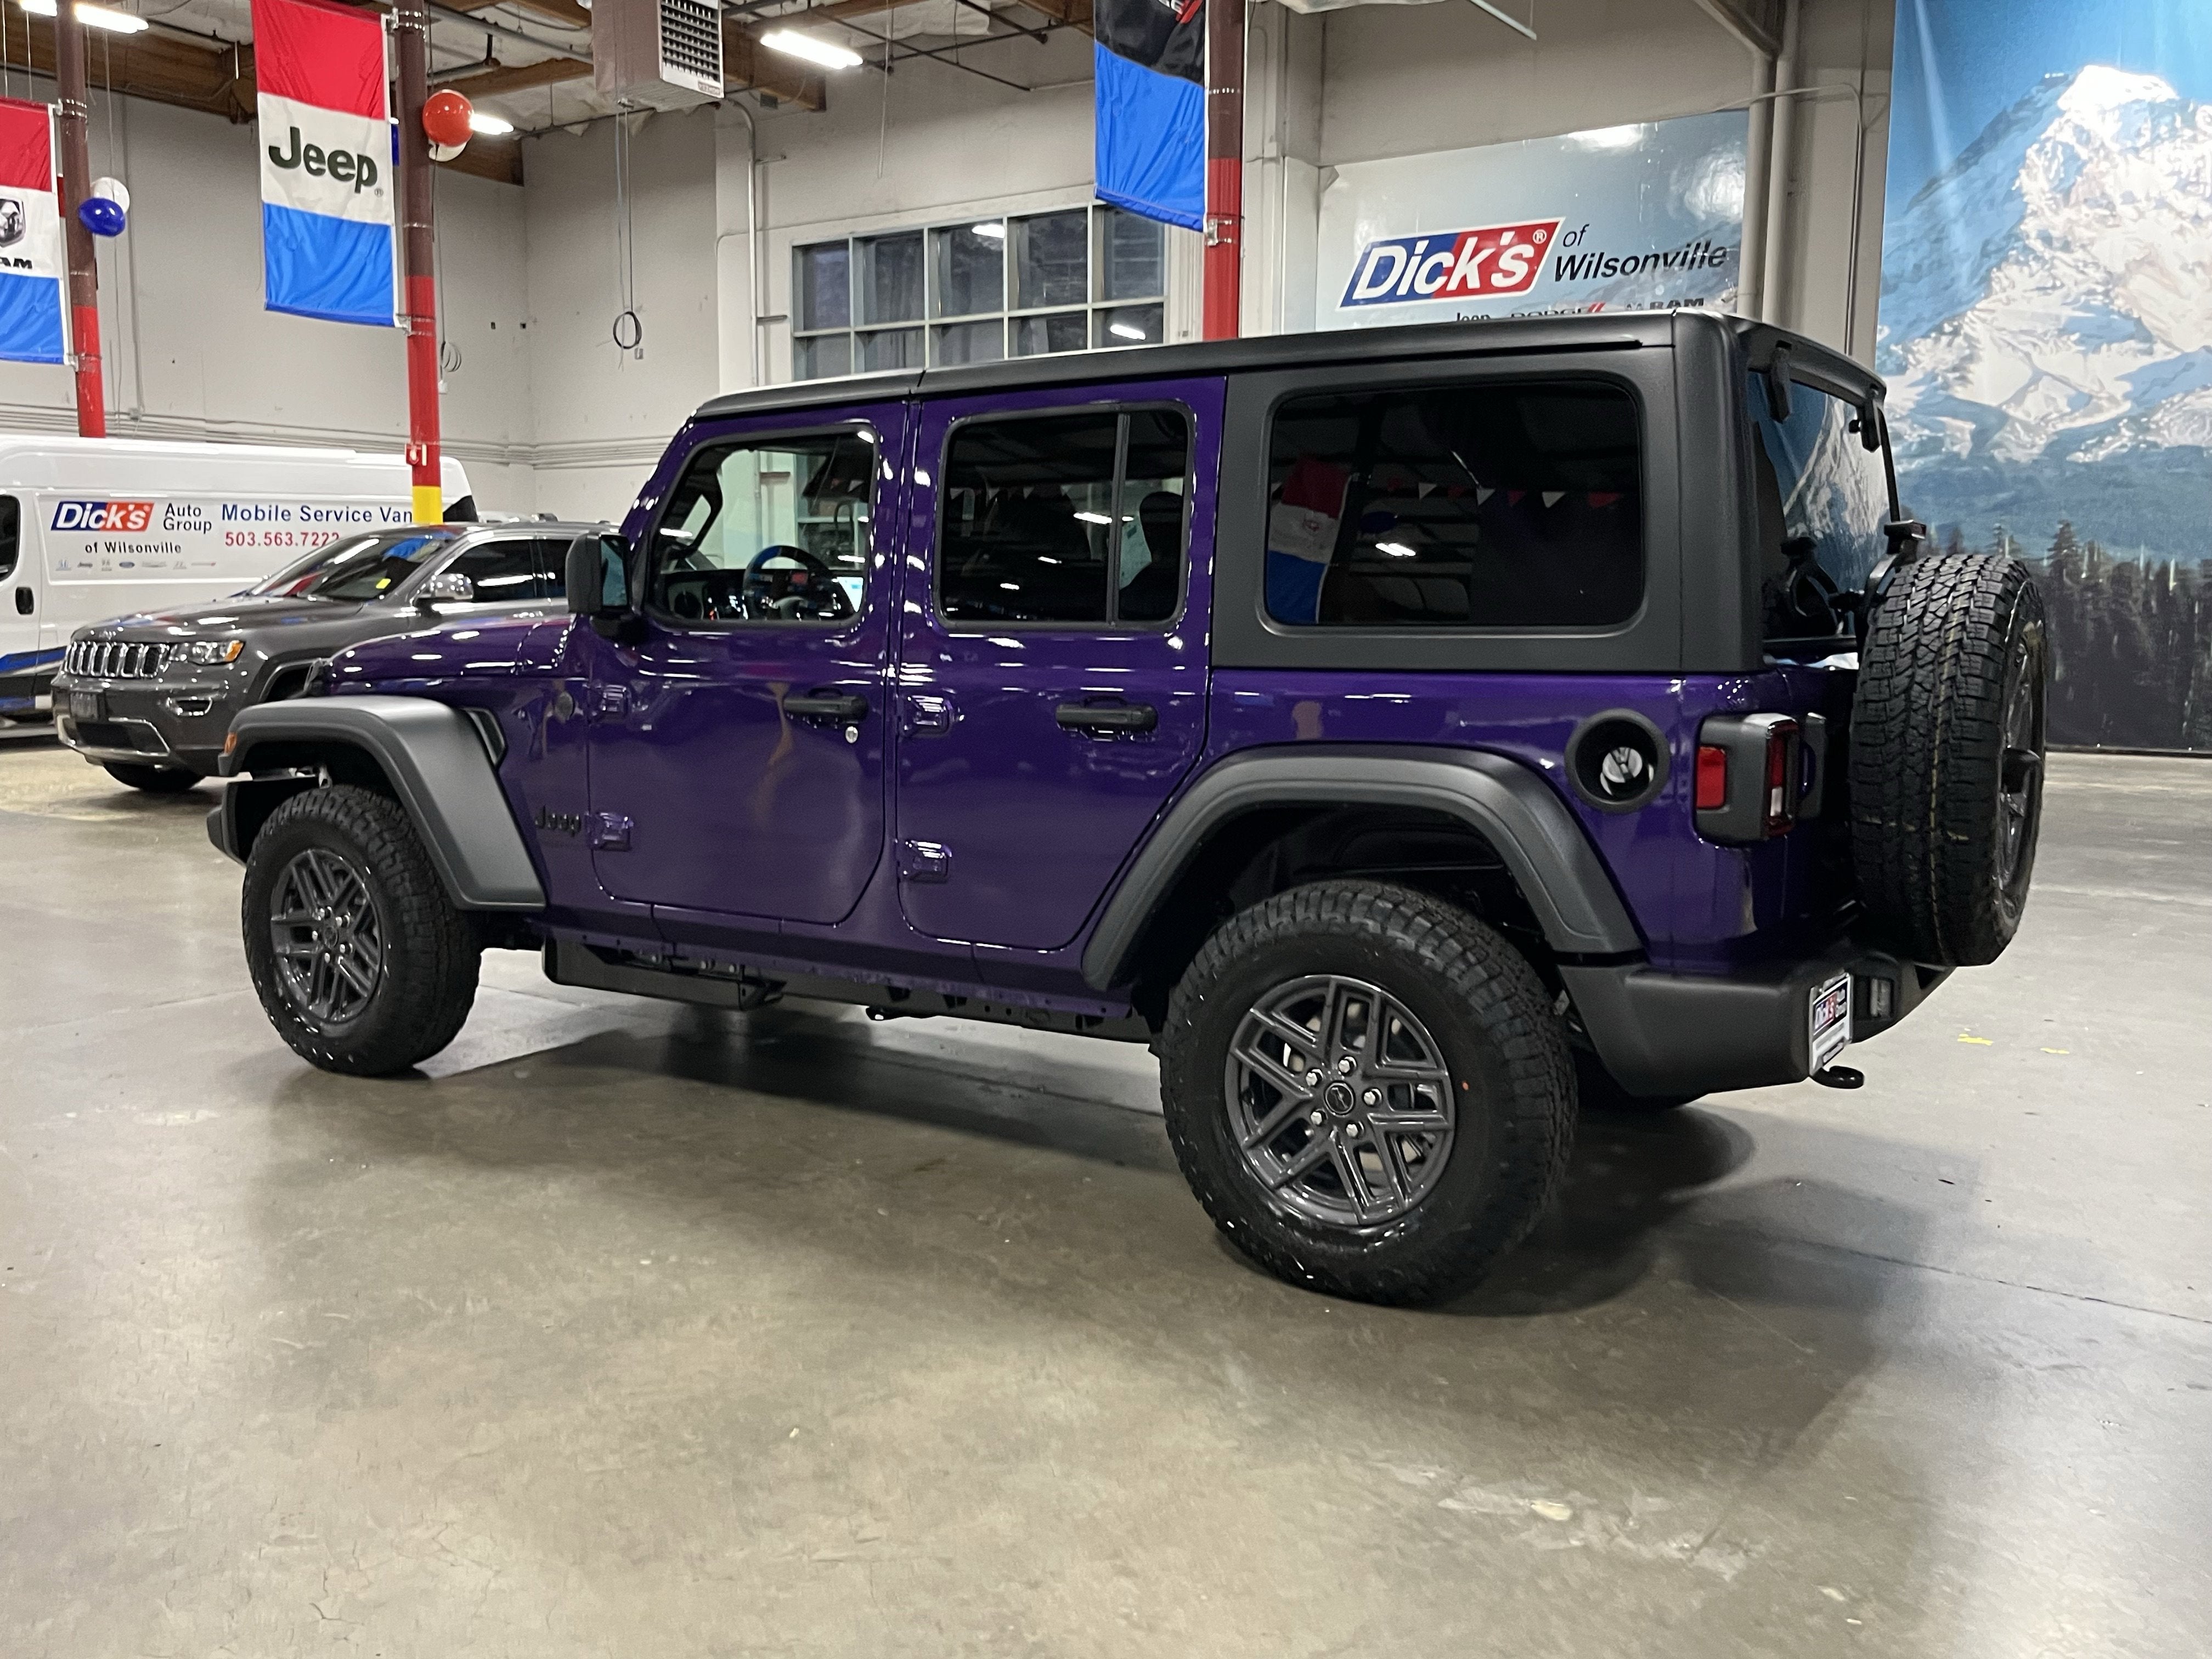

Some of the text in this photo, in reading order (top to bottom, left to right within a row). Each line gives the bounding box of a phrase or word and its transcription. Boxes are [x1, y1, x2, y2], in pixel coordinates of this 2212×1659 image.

[1562, 223, 1590, 247] of
[0, 256, 33, 269] AM
[1554, 238, 1728, 282] Wilsonville
[56, 503, 146, 529] Dick's
[165, 503, 202, 517] Auto
[222, 504, 413, 523] Mobile Service Van
[163, 517, 212, 534] Group
[85, 541, 182, 554] of Wilsonville
